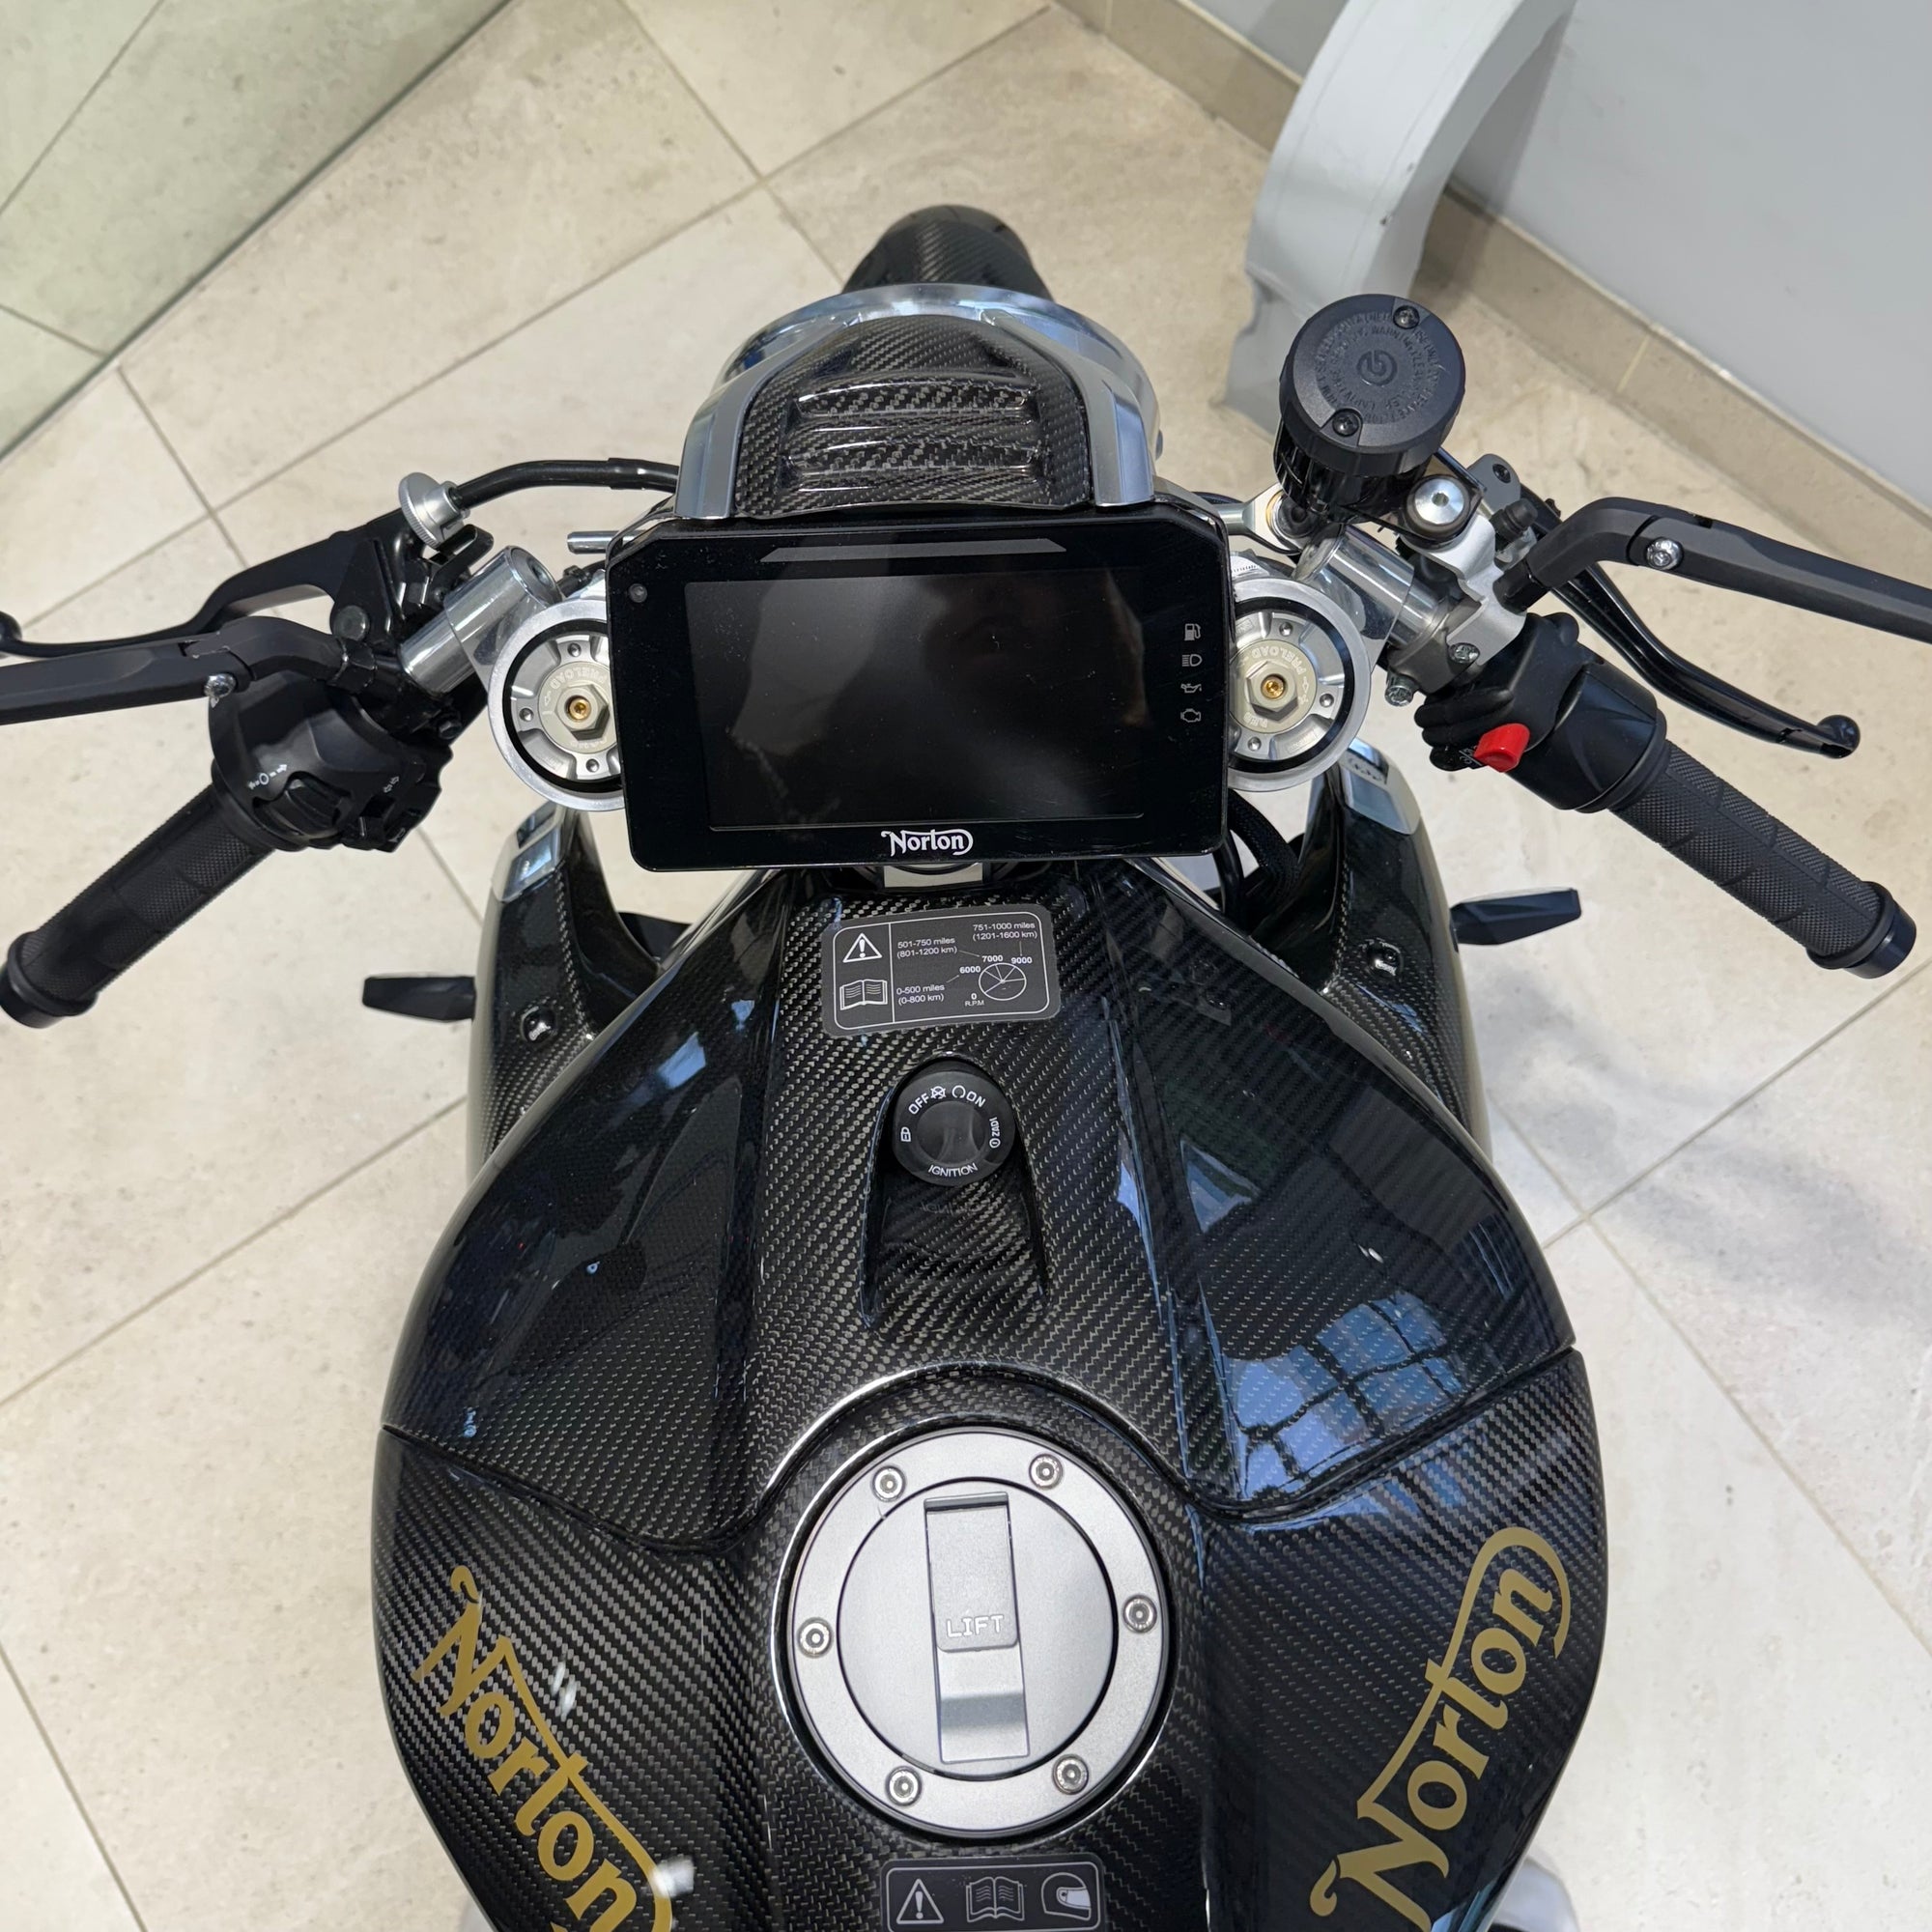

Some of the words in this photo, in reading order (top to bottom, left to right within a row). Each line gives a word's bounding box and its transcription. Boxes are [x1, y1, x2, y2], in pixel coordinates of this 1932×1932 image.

[1251, 645, 1306, 675] PRELOAD
[880, 829, 974, 857] Norton
[972, 923, 1012, 931] 751-1000
[897, 938, 932, 949] 501-750
[972, 931, 1020, 942] (1201-1600
[1021, 930, 1038, 939] km)
[896, 948, 940, 959] (801-1200
[941, 946, 958, 954] km)
[981, 954, 1004, 963] 7000
[1010, 956, 1033, 965] 9000
[896, 985, 921, 996] 0-500
[923, 983, 945, 992] miles
[898, 994, 926, 1006] (0-800
[927, 993, 945, 1003] km)
[908, 1093, 929, 1115] OFF
[966, 1091, 986, 1107] ON
[988, 1117, 1001, 1137] ZADI
[928, 1162, 979, 1178] IGNITION
[947, 1614, 1004, 1637] LIFT
[1310, 1526, 1571, 1932] Norton
[411, 1565, 672, 1932] Norton
